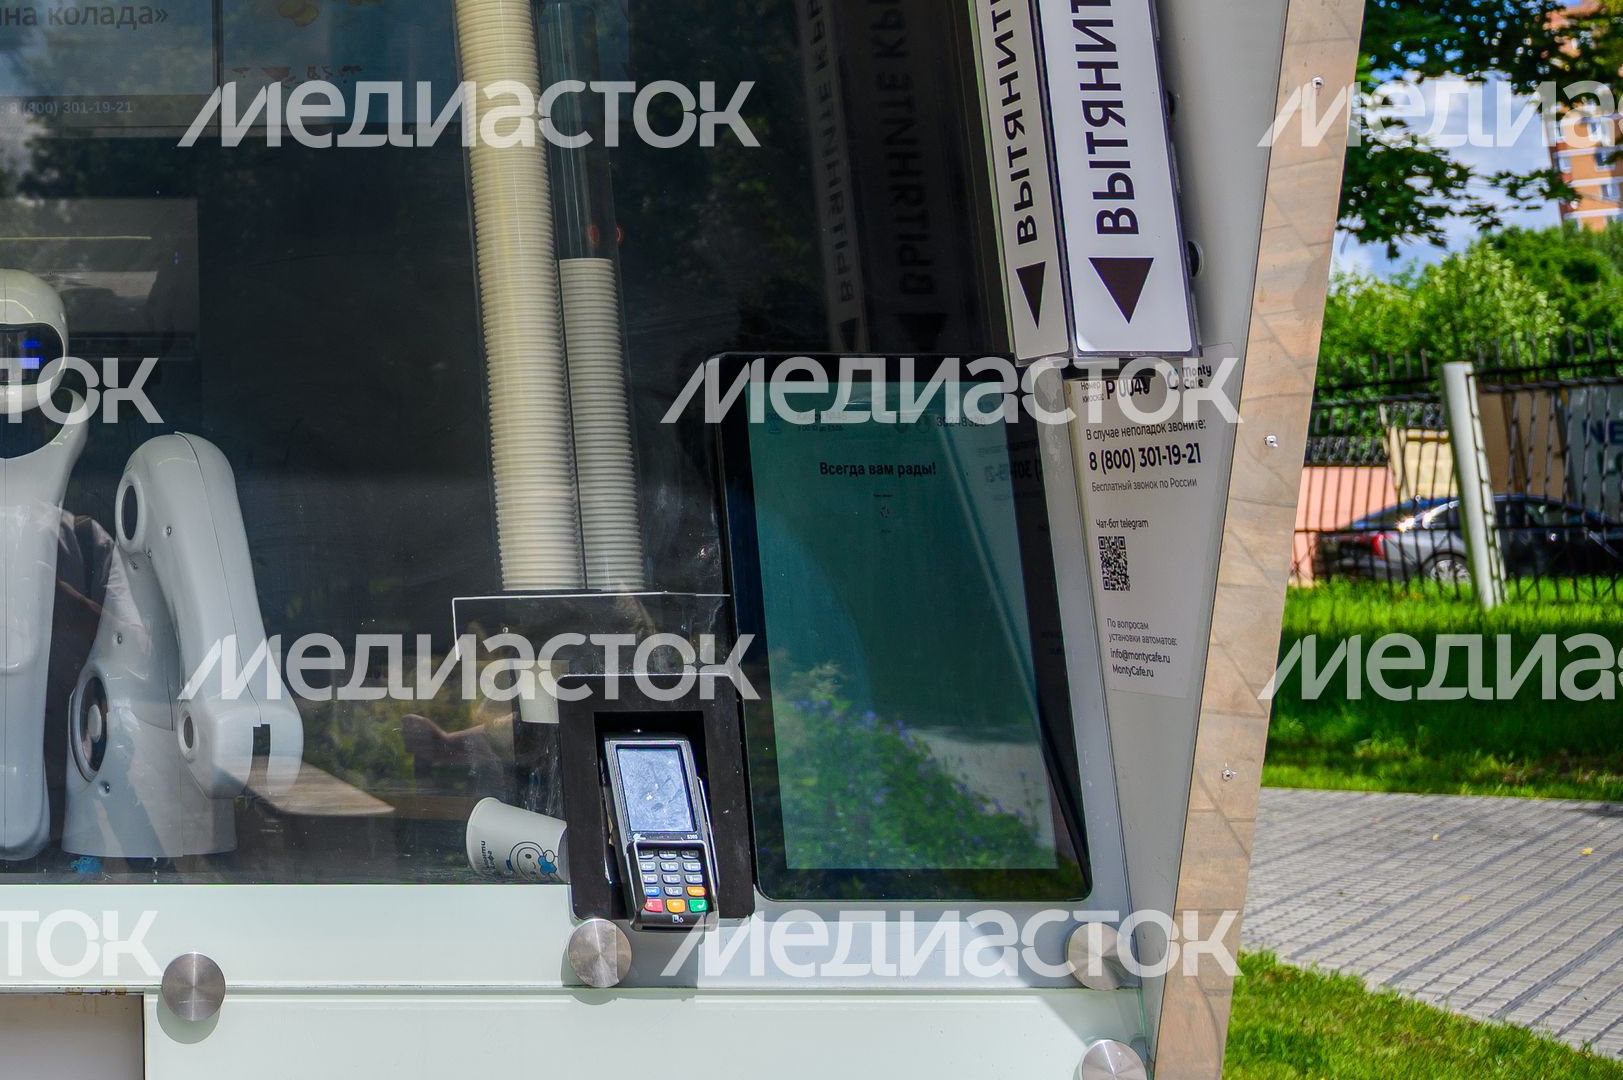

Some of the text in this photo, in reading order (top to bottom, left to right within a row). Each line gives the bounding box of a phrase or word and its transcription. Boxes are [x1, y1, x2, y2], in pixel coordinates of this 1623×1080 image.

[48, 5, 169, 30] колада»
[1086, 420, 1206, 442] В случае неполадок звоните:
[1089, 442, 1202, 475] 8 (800) 301-19-21
[819, 461, 936, 478] Всегда вам рады!
[1091, 477, 1197, 492] Бесплатный звонок по России
[1096, 518, 1149, 530] Чат-бот telegram
[1107, 618, 1149, 632] По вопросам
[1108, 633, 1141, 644] установки
[1110, 648, 1171, 664] info@montycafe.ru
[1112, 664, 1154, 678] MontyCafe.ru
